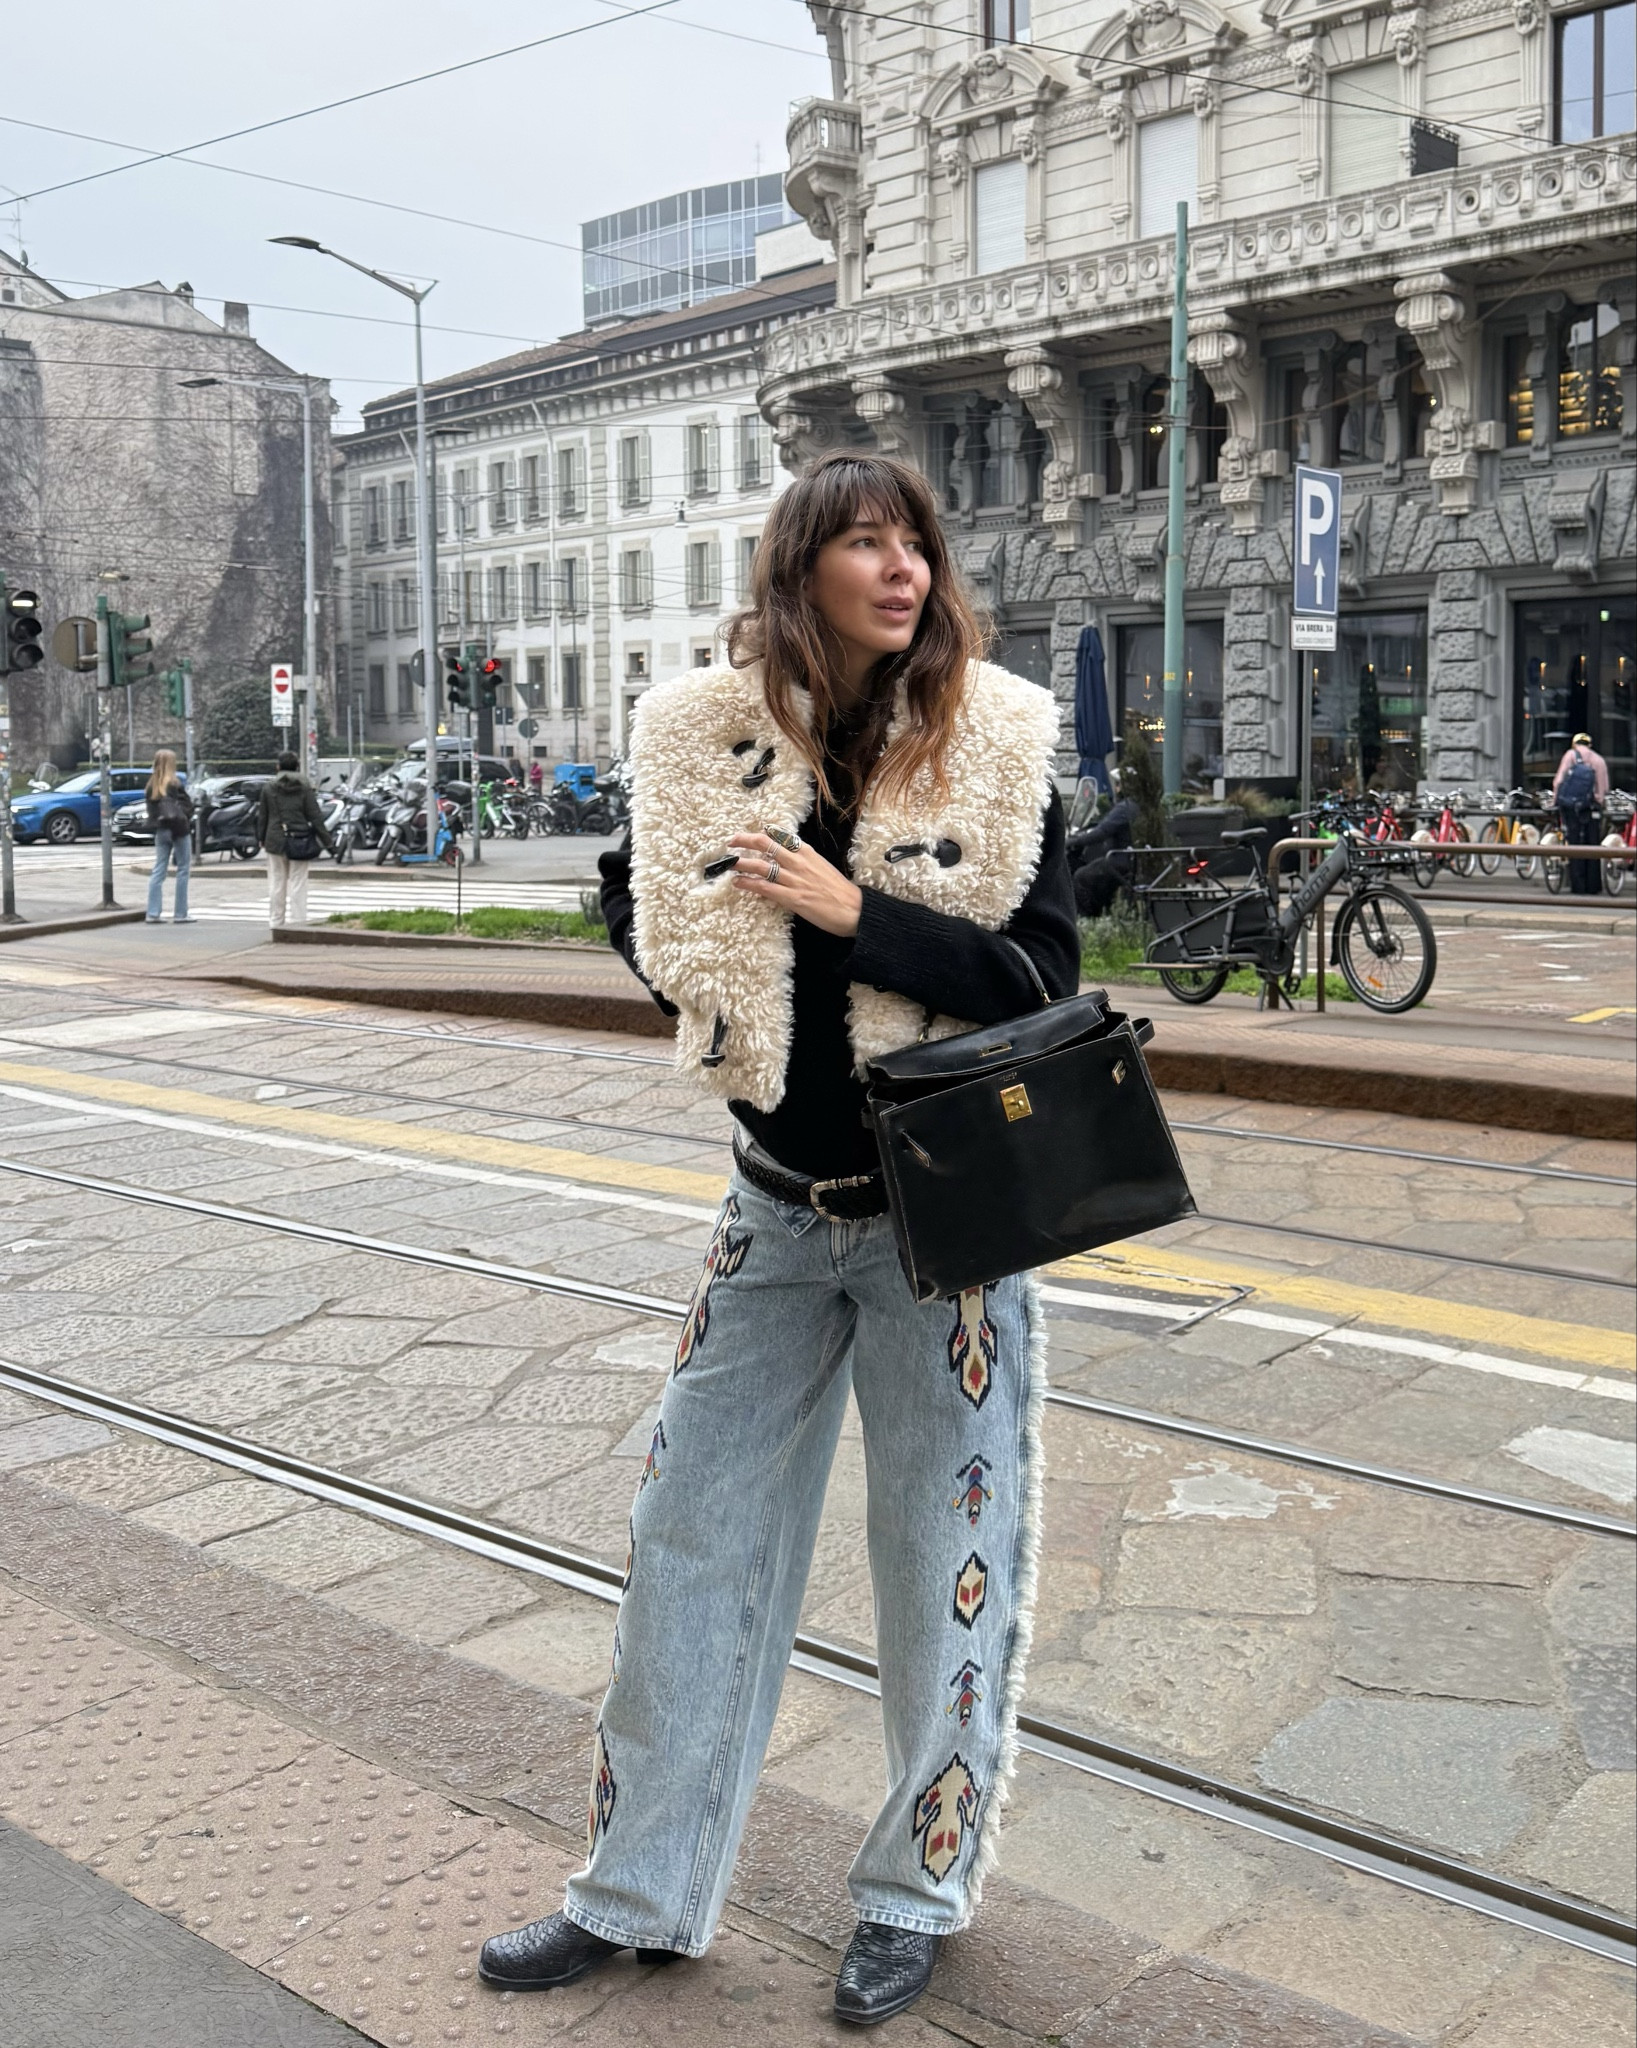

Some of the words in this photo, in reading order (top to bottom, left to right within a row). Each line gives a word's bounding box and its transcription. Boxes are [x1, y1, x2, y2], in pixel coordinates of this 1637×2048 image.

[1301, 478, 1334, 565] P
[1295, 623, 1305, 632] VIA
[1306, 623, 1324, 632] BRERA
